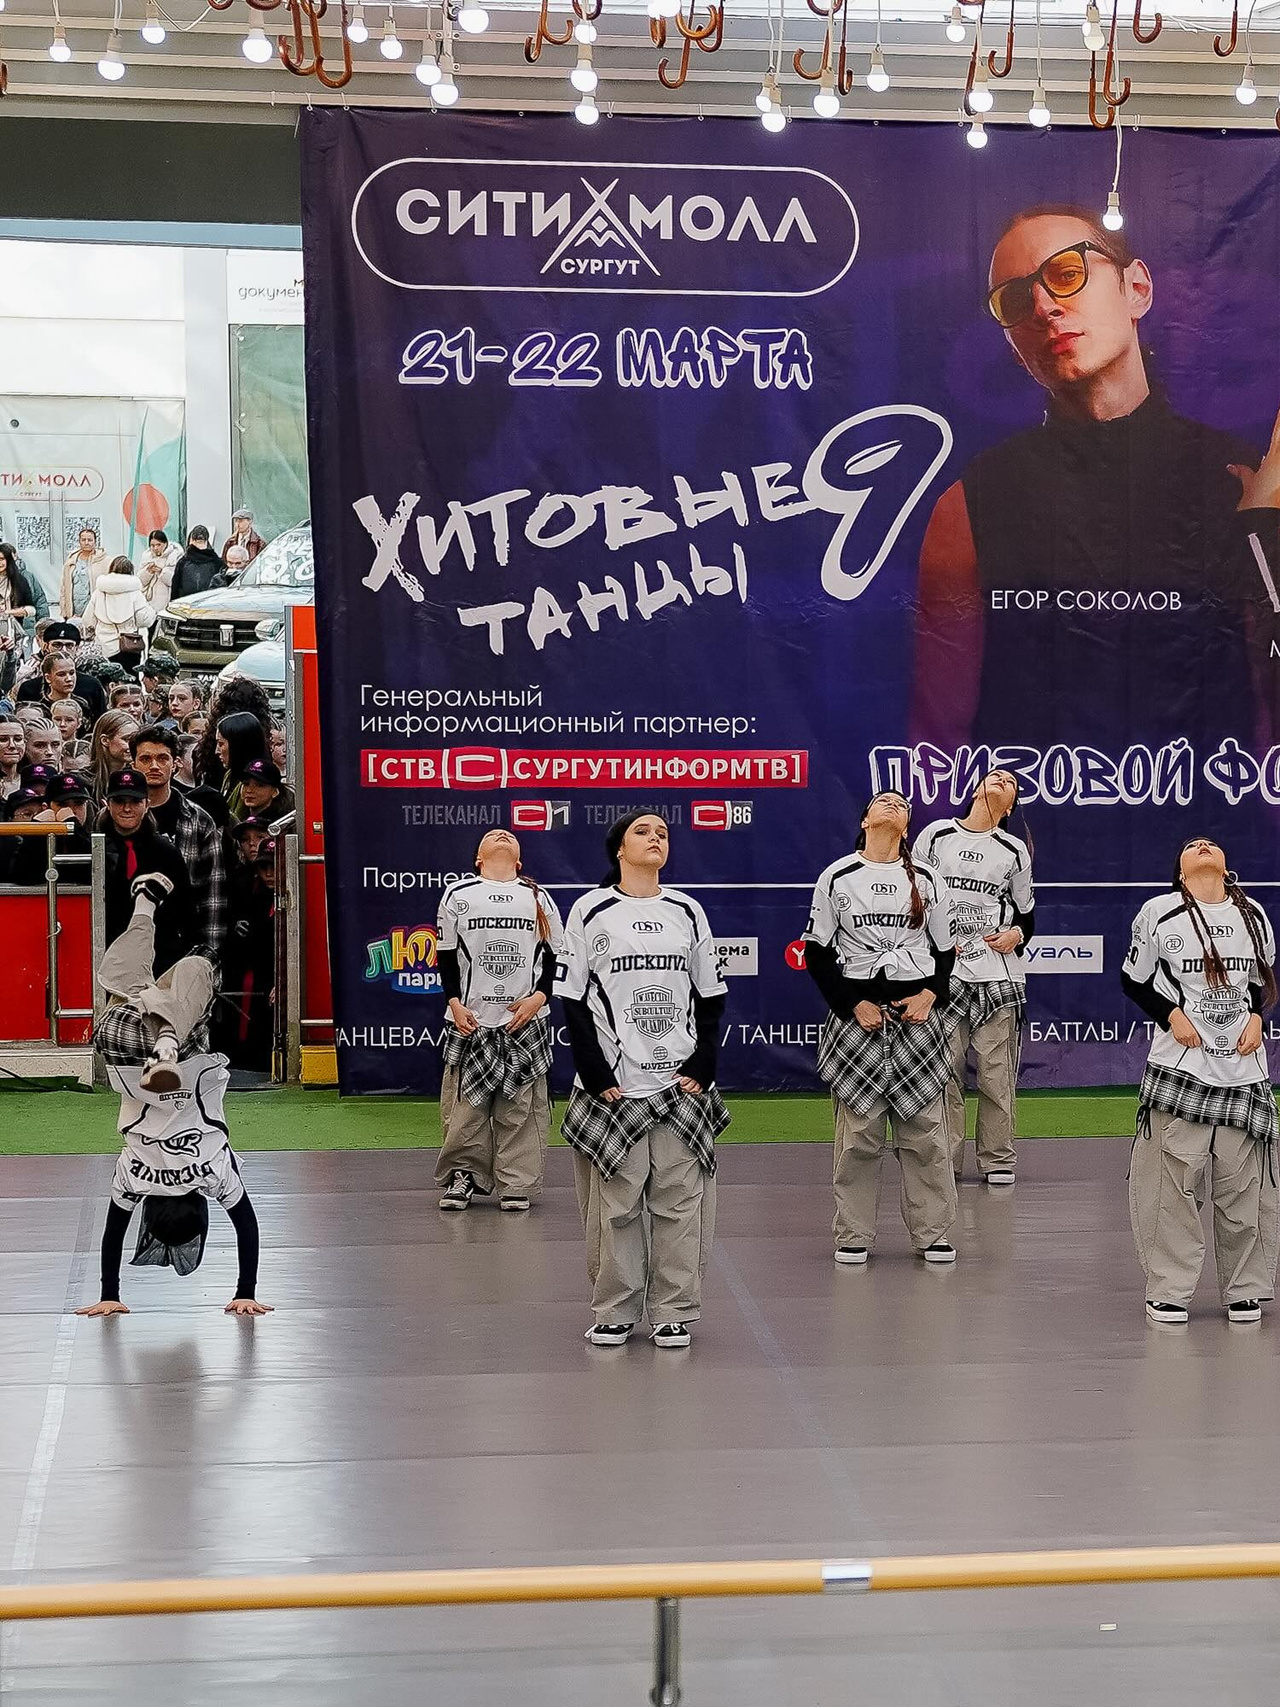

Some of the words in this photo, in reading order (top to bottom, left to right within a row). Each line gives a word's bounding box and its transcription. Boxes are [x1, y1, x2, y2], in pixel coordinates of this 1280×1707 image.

[395, 188, 571, 236] СИТИ
[629, 193, 818, 243] МОЛЛ
[560, 257, 640, 275] СУРГУТ
[399, 327, 601, 386] 21-22
[617, 326, 812, 390] МАРТА
[460, 543, 749, 655] ТАНЦЫ
[991, 590, 1049, 610] ЕГОР
[1056, 590, 1182, 611] СОКОЛОВ
[360, 684, 543, 711] Генеральный
[360, 711, 624, 737] информационный
[633, 716, 757, 738] партнер:
[868, 737, 1195, 806] ПРИЗОВОЙ
[402, 804, 501, 826] ТЕЛЕКАНАЛ
[468, 917, 535, 931] DUCKDIVE
[1030, 1022, 1118, 1042] БАТТЛЫ
